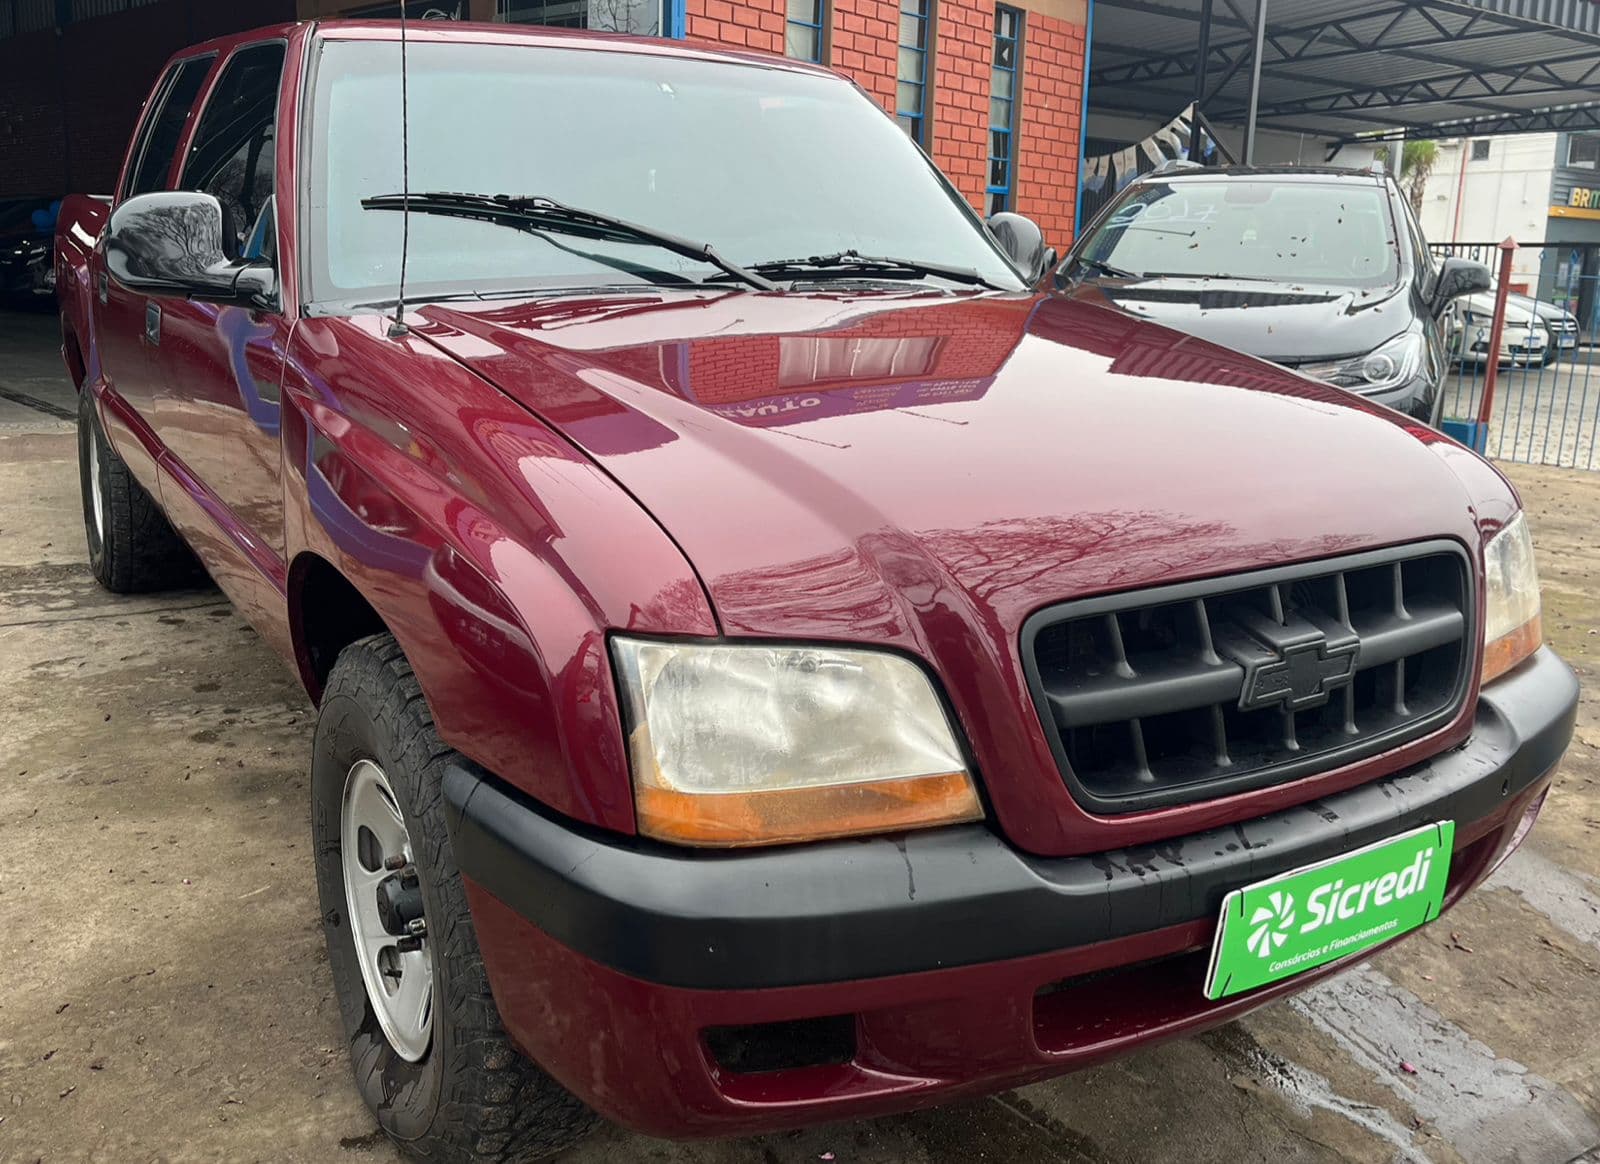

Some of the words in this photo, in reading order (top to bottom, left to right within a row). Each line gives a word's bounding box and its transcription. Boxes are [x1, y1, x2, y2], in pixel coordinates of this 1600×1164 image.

[1300, 847, 1434, 934] Sicredi
[1268, 946, 1320, 973] Consórcios
[1322, 945, 1329, 954] e
[1329, 918, 1399, 951] Financiamentos
